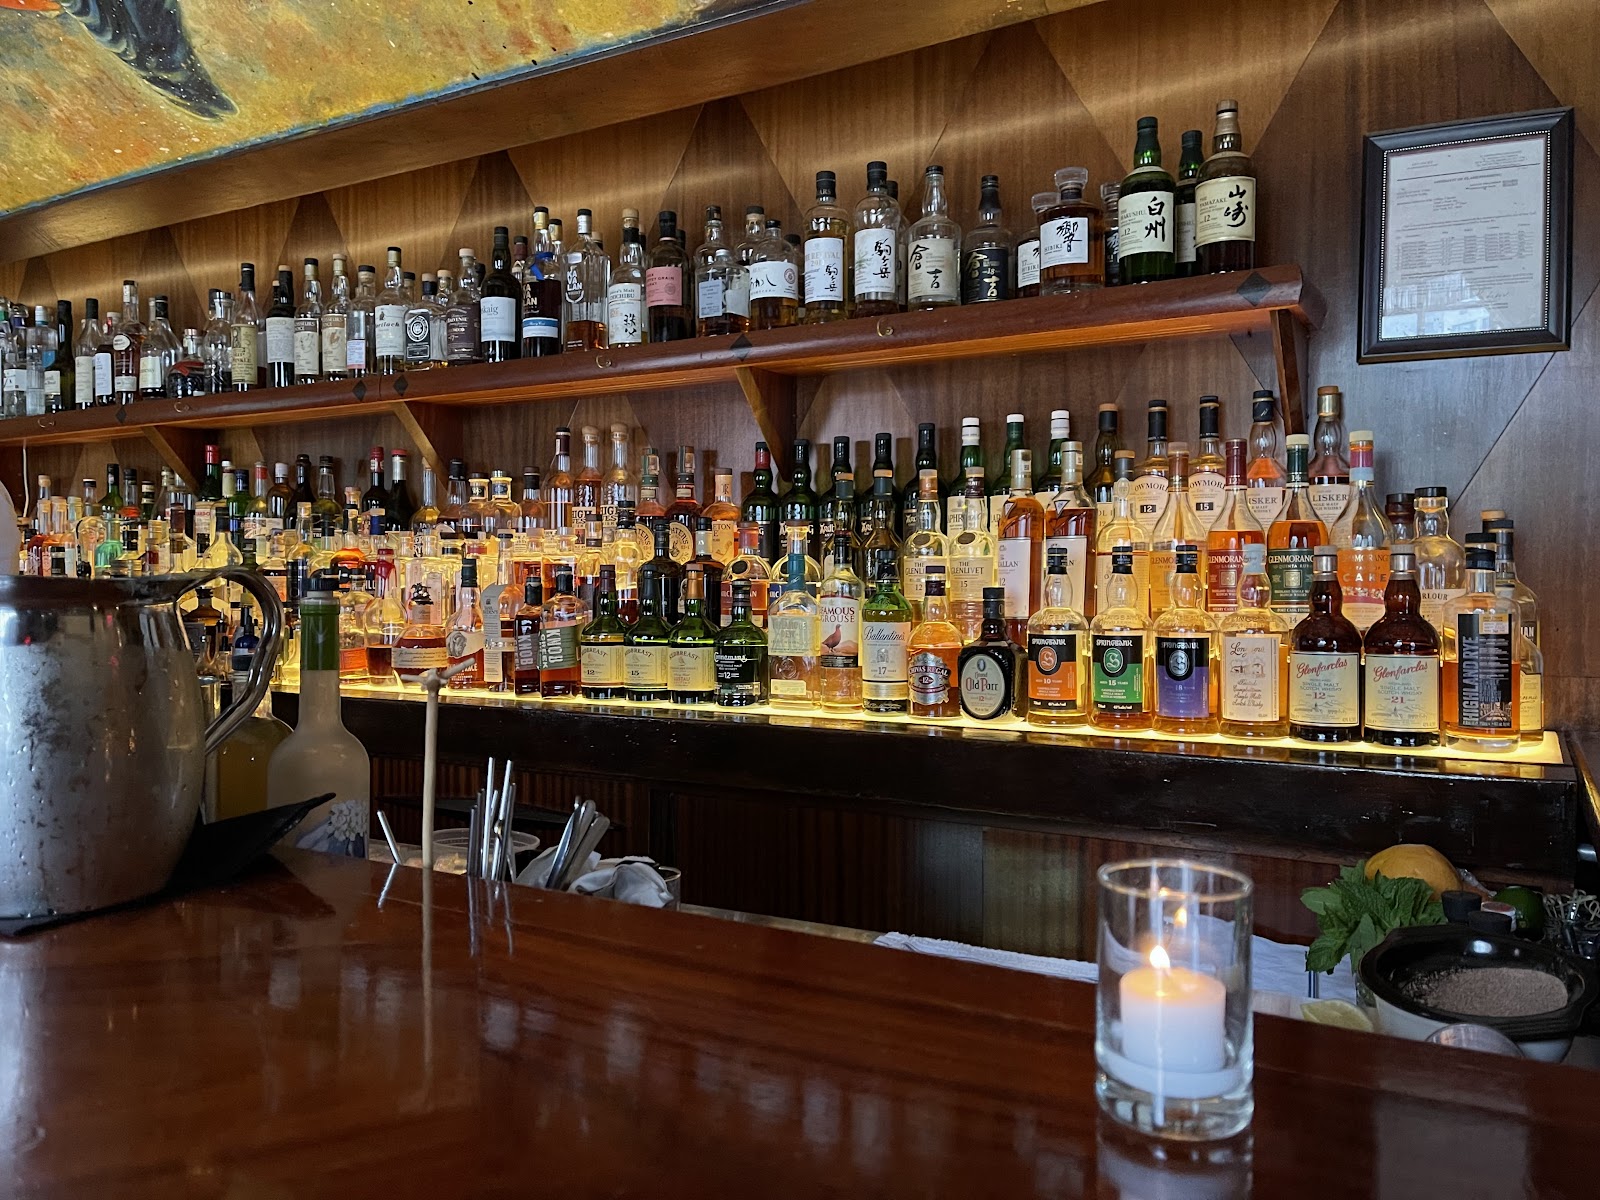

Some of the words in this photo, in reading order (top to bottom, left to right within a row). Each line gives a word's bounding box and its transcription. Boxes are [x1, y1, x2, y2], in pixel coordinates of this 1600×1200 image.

[1144, 196, 1166, 243] 白州
[1203, 214, 1211, 223] 12
[1124, 227, 1131, 236] 12
[1248, 496, 1278, 504] ISKER
[1312, 493, 1347, 502] LISKER
[1143, 505, 1153, 513] 12
[1199, 503, 1209, 511] 15
[1208, 555, 1244, 564] GLENMORAN
[1268, 554, 1314, 564] GLENMORANG
[997, 560, 1020, 568] ALLAN
[951, 567, 984, 575] GLENLIVET
[1342, 573, 1387, 582] CAKE
[960, 580, 968, 588] 15
[1421, 592, 1448, 600] RLOUR
[864, 625, 906, 641] Ballantine's
[518, 635, 533, 665] KNOB
[1462, 636, 1479, 659] RYE
[878, 666, 887, 675] 17
[927, 666, 949, 677] REGAL
[1296, 657, 1348, 679] Glenfarclas
[1373, 660, 1428, 682] Glenfarclas
[724, 671, 731, 679] 12
[966, 677, 979, 692] Old
[980, 677, 999, 691] Parr
[1313, 691, 1326, 700] 12
[1462, 660, 1479, 722] HIGHLAND
[1391, 696, 1405, 704] 21
